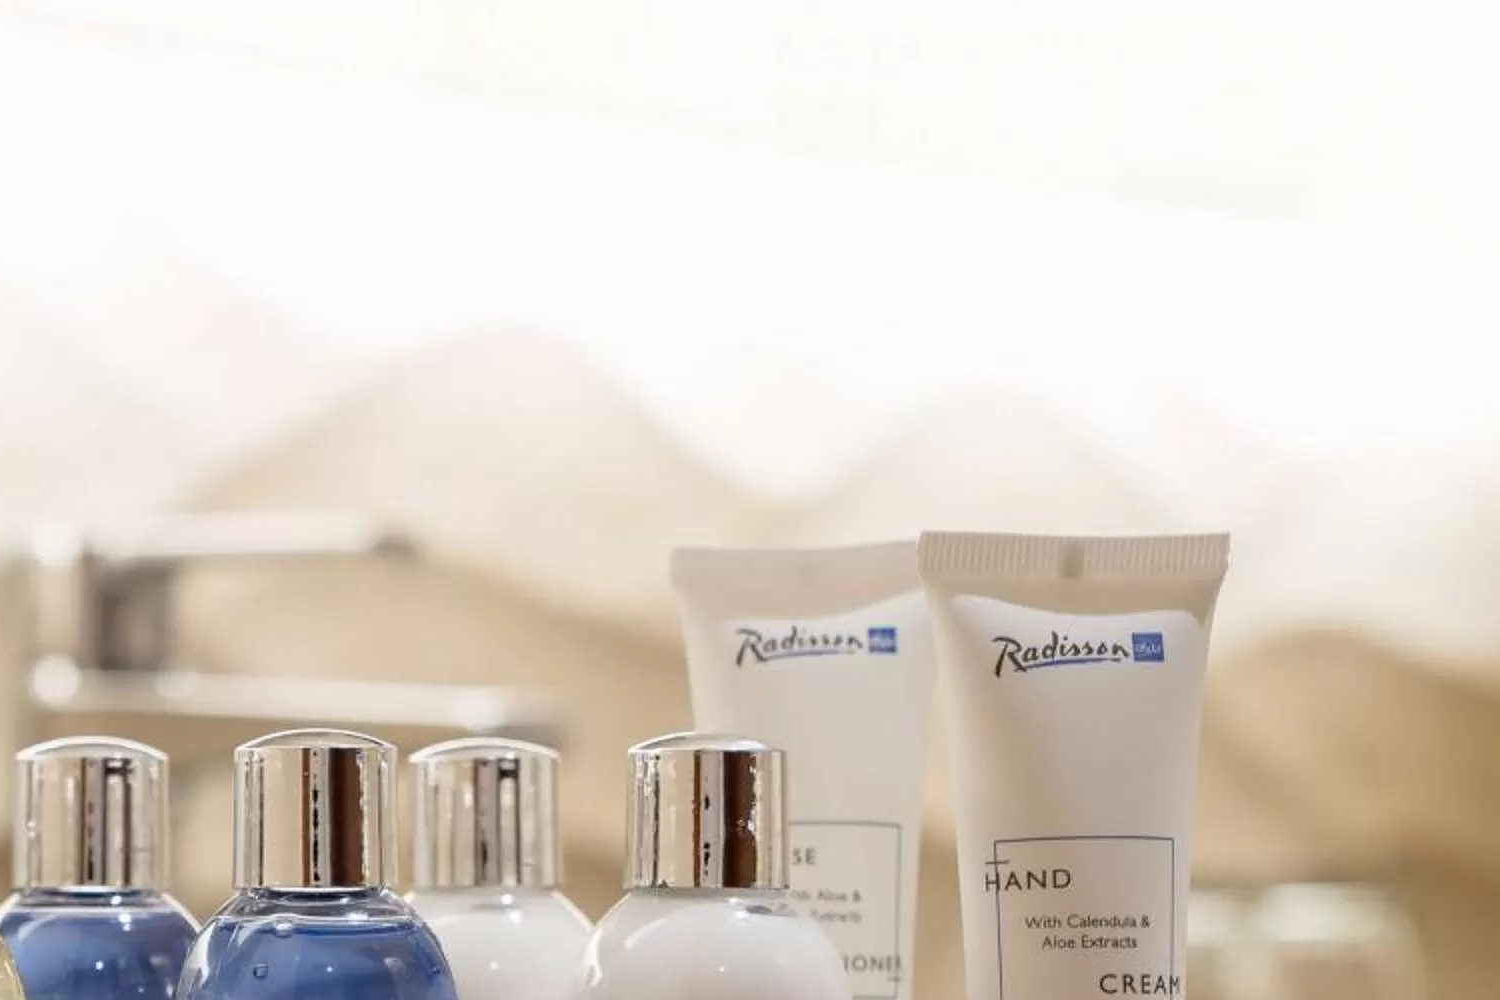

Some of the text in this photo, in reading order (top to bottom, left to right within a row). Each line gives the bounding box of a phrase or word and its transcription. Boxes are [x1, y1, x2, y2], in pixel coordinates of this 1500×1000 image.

[736, 625, 864, 667] Radisson
[992, 631, 1130, 678] Radisson
[985, 868, 1071, 892] HAND
[1025, 914, 1150, 929] With Calendula &
[1041, 934, 1138, 949] Aloe Extracts
[1100, 973, 1180, 995] CREAM
